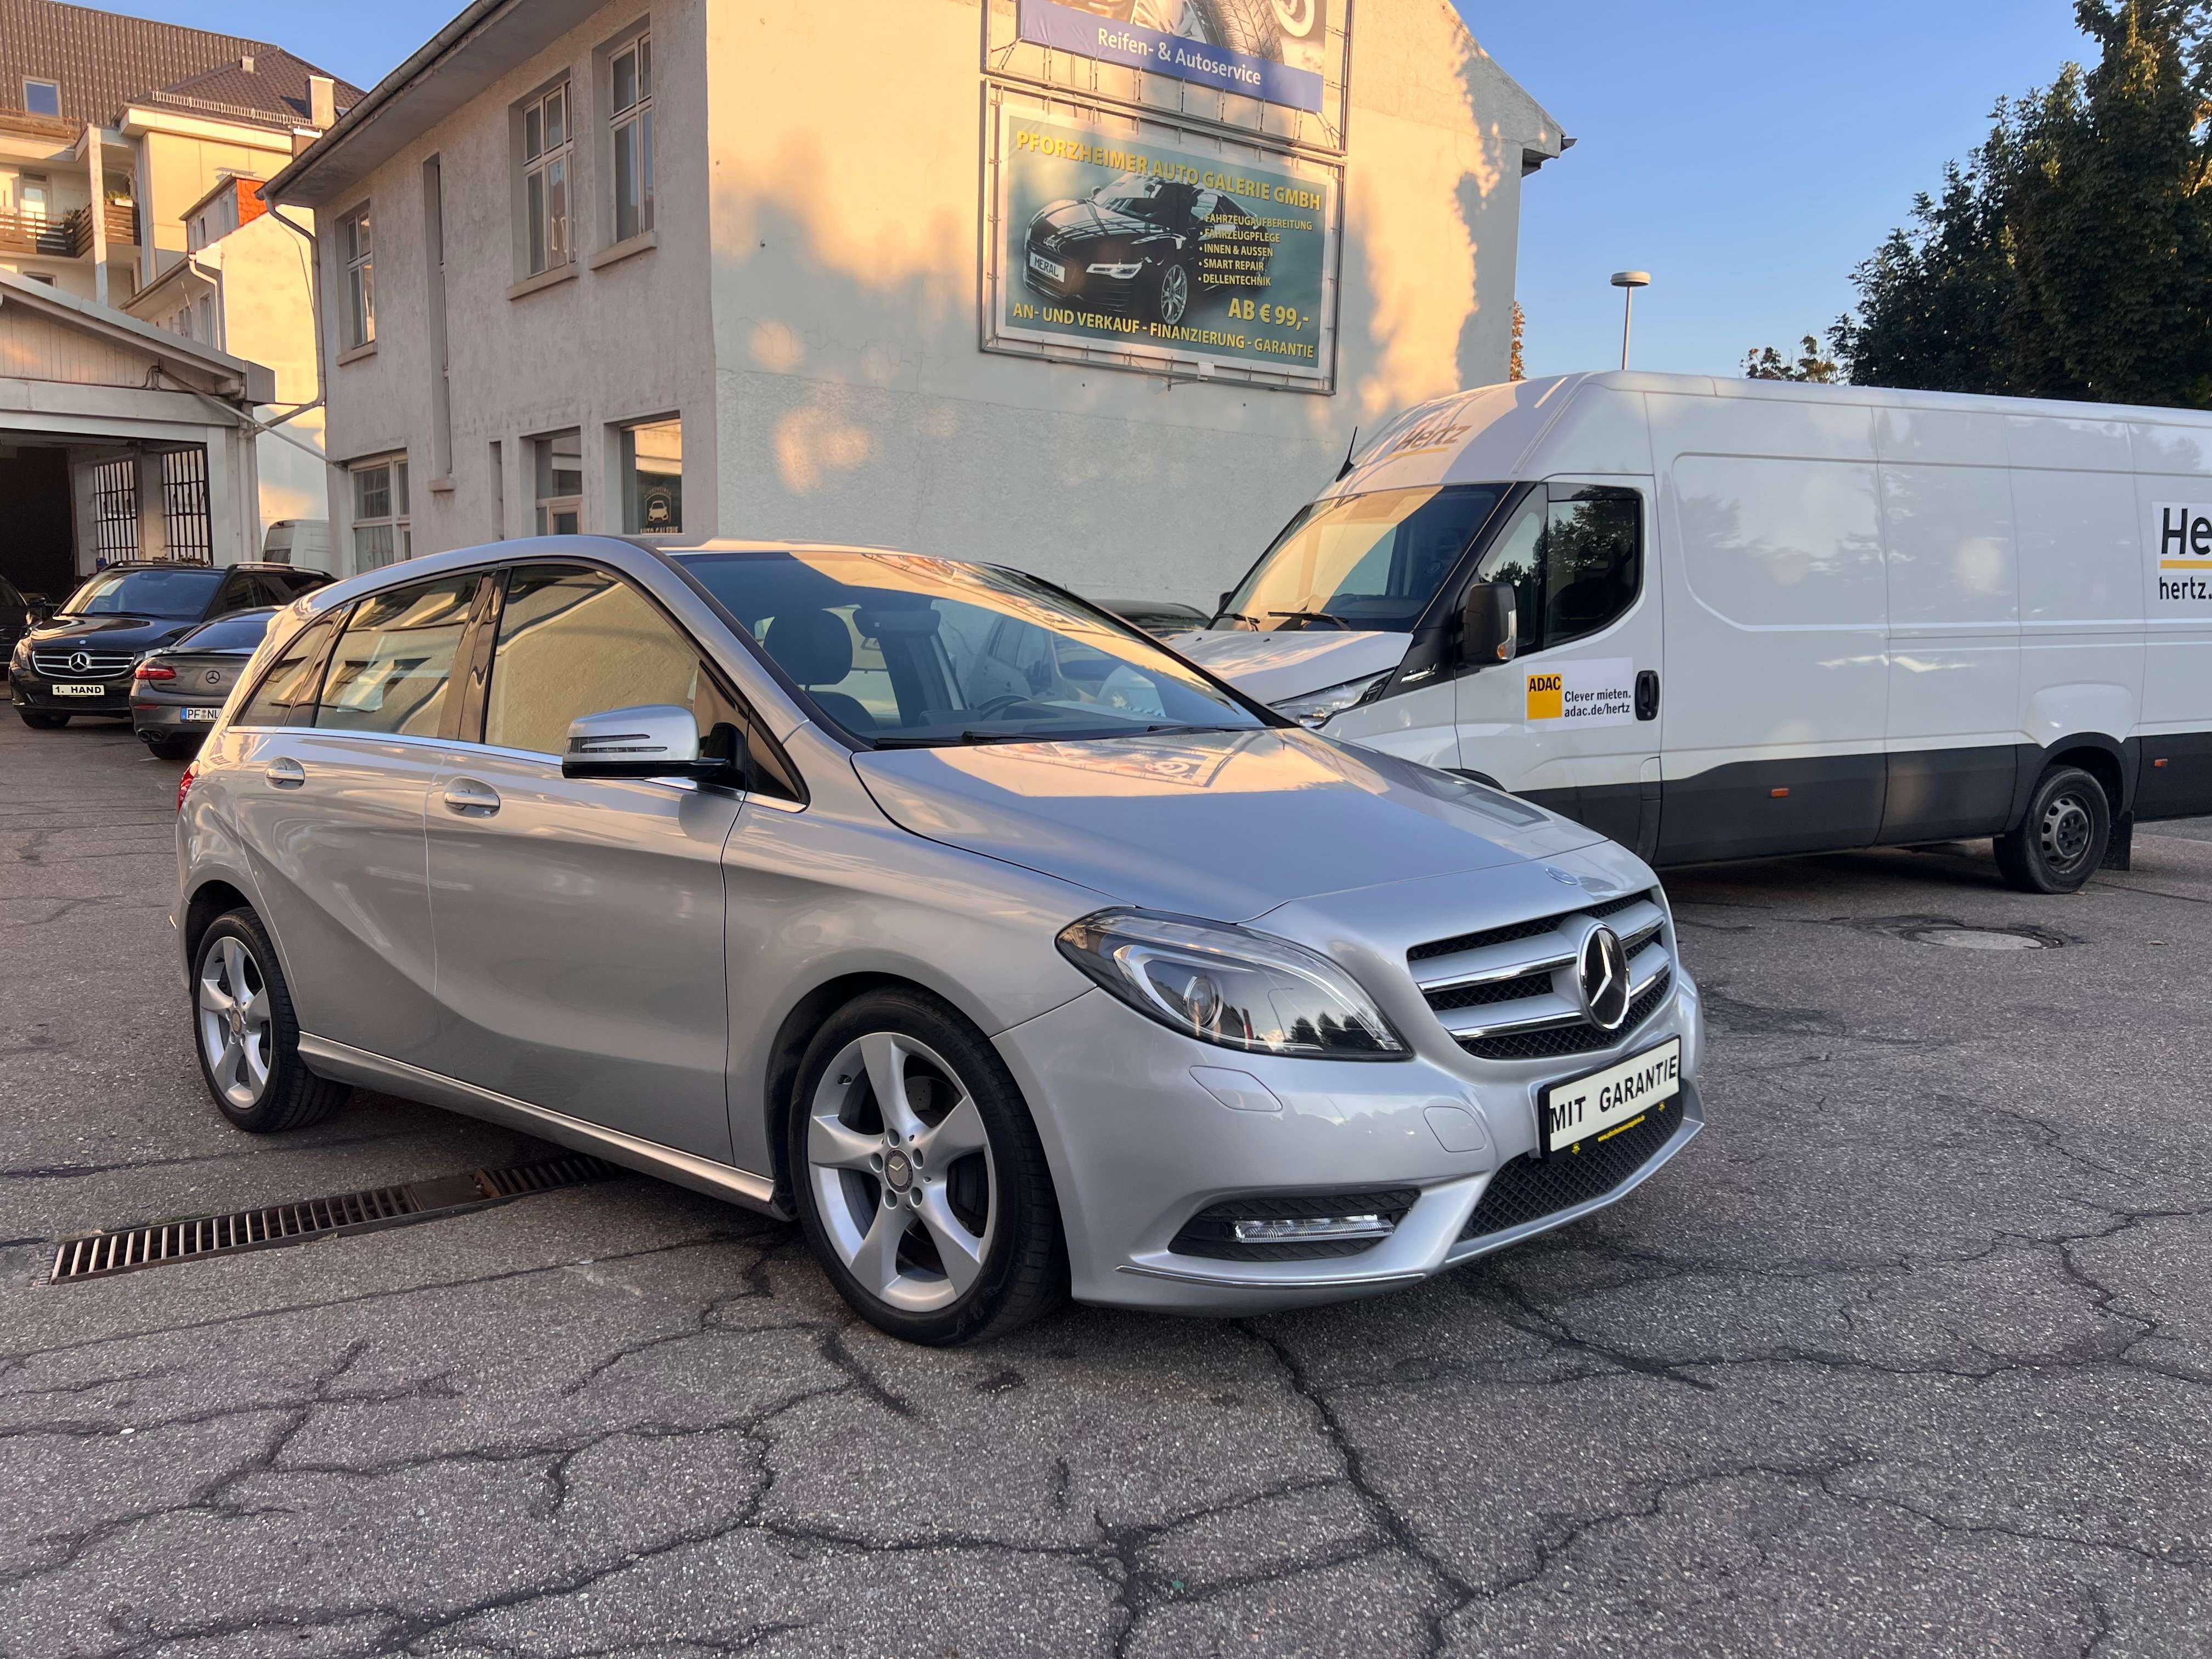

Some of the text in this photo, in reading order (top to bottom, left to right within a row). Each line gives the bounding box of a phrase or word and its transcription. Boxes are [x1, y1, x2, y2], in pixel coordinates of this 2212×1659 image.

[1098, 27, 1261, 85] Reifen- & Autoservice
[1017, 131, 1321, 211] PFORZHEIMER AUTO GALERIE GMBH
[1205, 213, 1313, 231] FAHRZEUGAUFBEREITUNG
[1204, 228, 1281, 243] FAHRZEUGPFLEGE
[1204, 243, 1274, 257] INNEN & AUSSEN
[1035, 256, 1059, 278] MERAL
[1203, 258, 1264, 271] SMART REPAIR
[1203, 273, 1271, 286] DELLENTECHNIK
[1228, 298, 1310, 330] AB € 99,-
[1013, 303, 1039, 320] AN-
[1043, 307, 1074, 325] UND
[1077, 311, 1141, 334] VERKAUF
[1149, 322, 1245, 349] FINANZIERUNG
[1254, 337, 1314, 359] GARANTIE
[1392, 424, 1472, 452] Hertz
[1528, 676, 1561, 692] ADAC
[1565, 689, 1632, 702] Clever mieten.
[188, 709, 201, 718] PF
[1565, 703, 1630, 718] adac.de/hertz
[1549, 1096, 1586, 1134] MIT
[1599, 1054, 1677, 1113] GARANTIE
